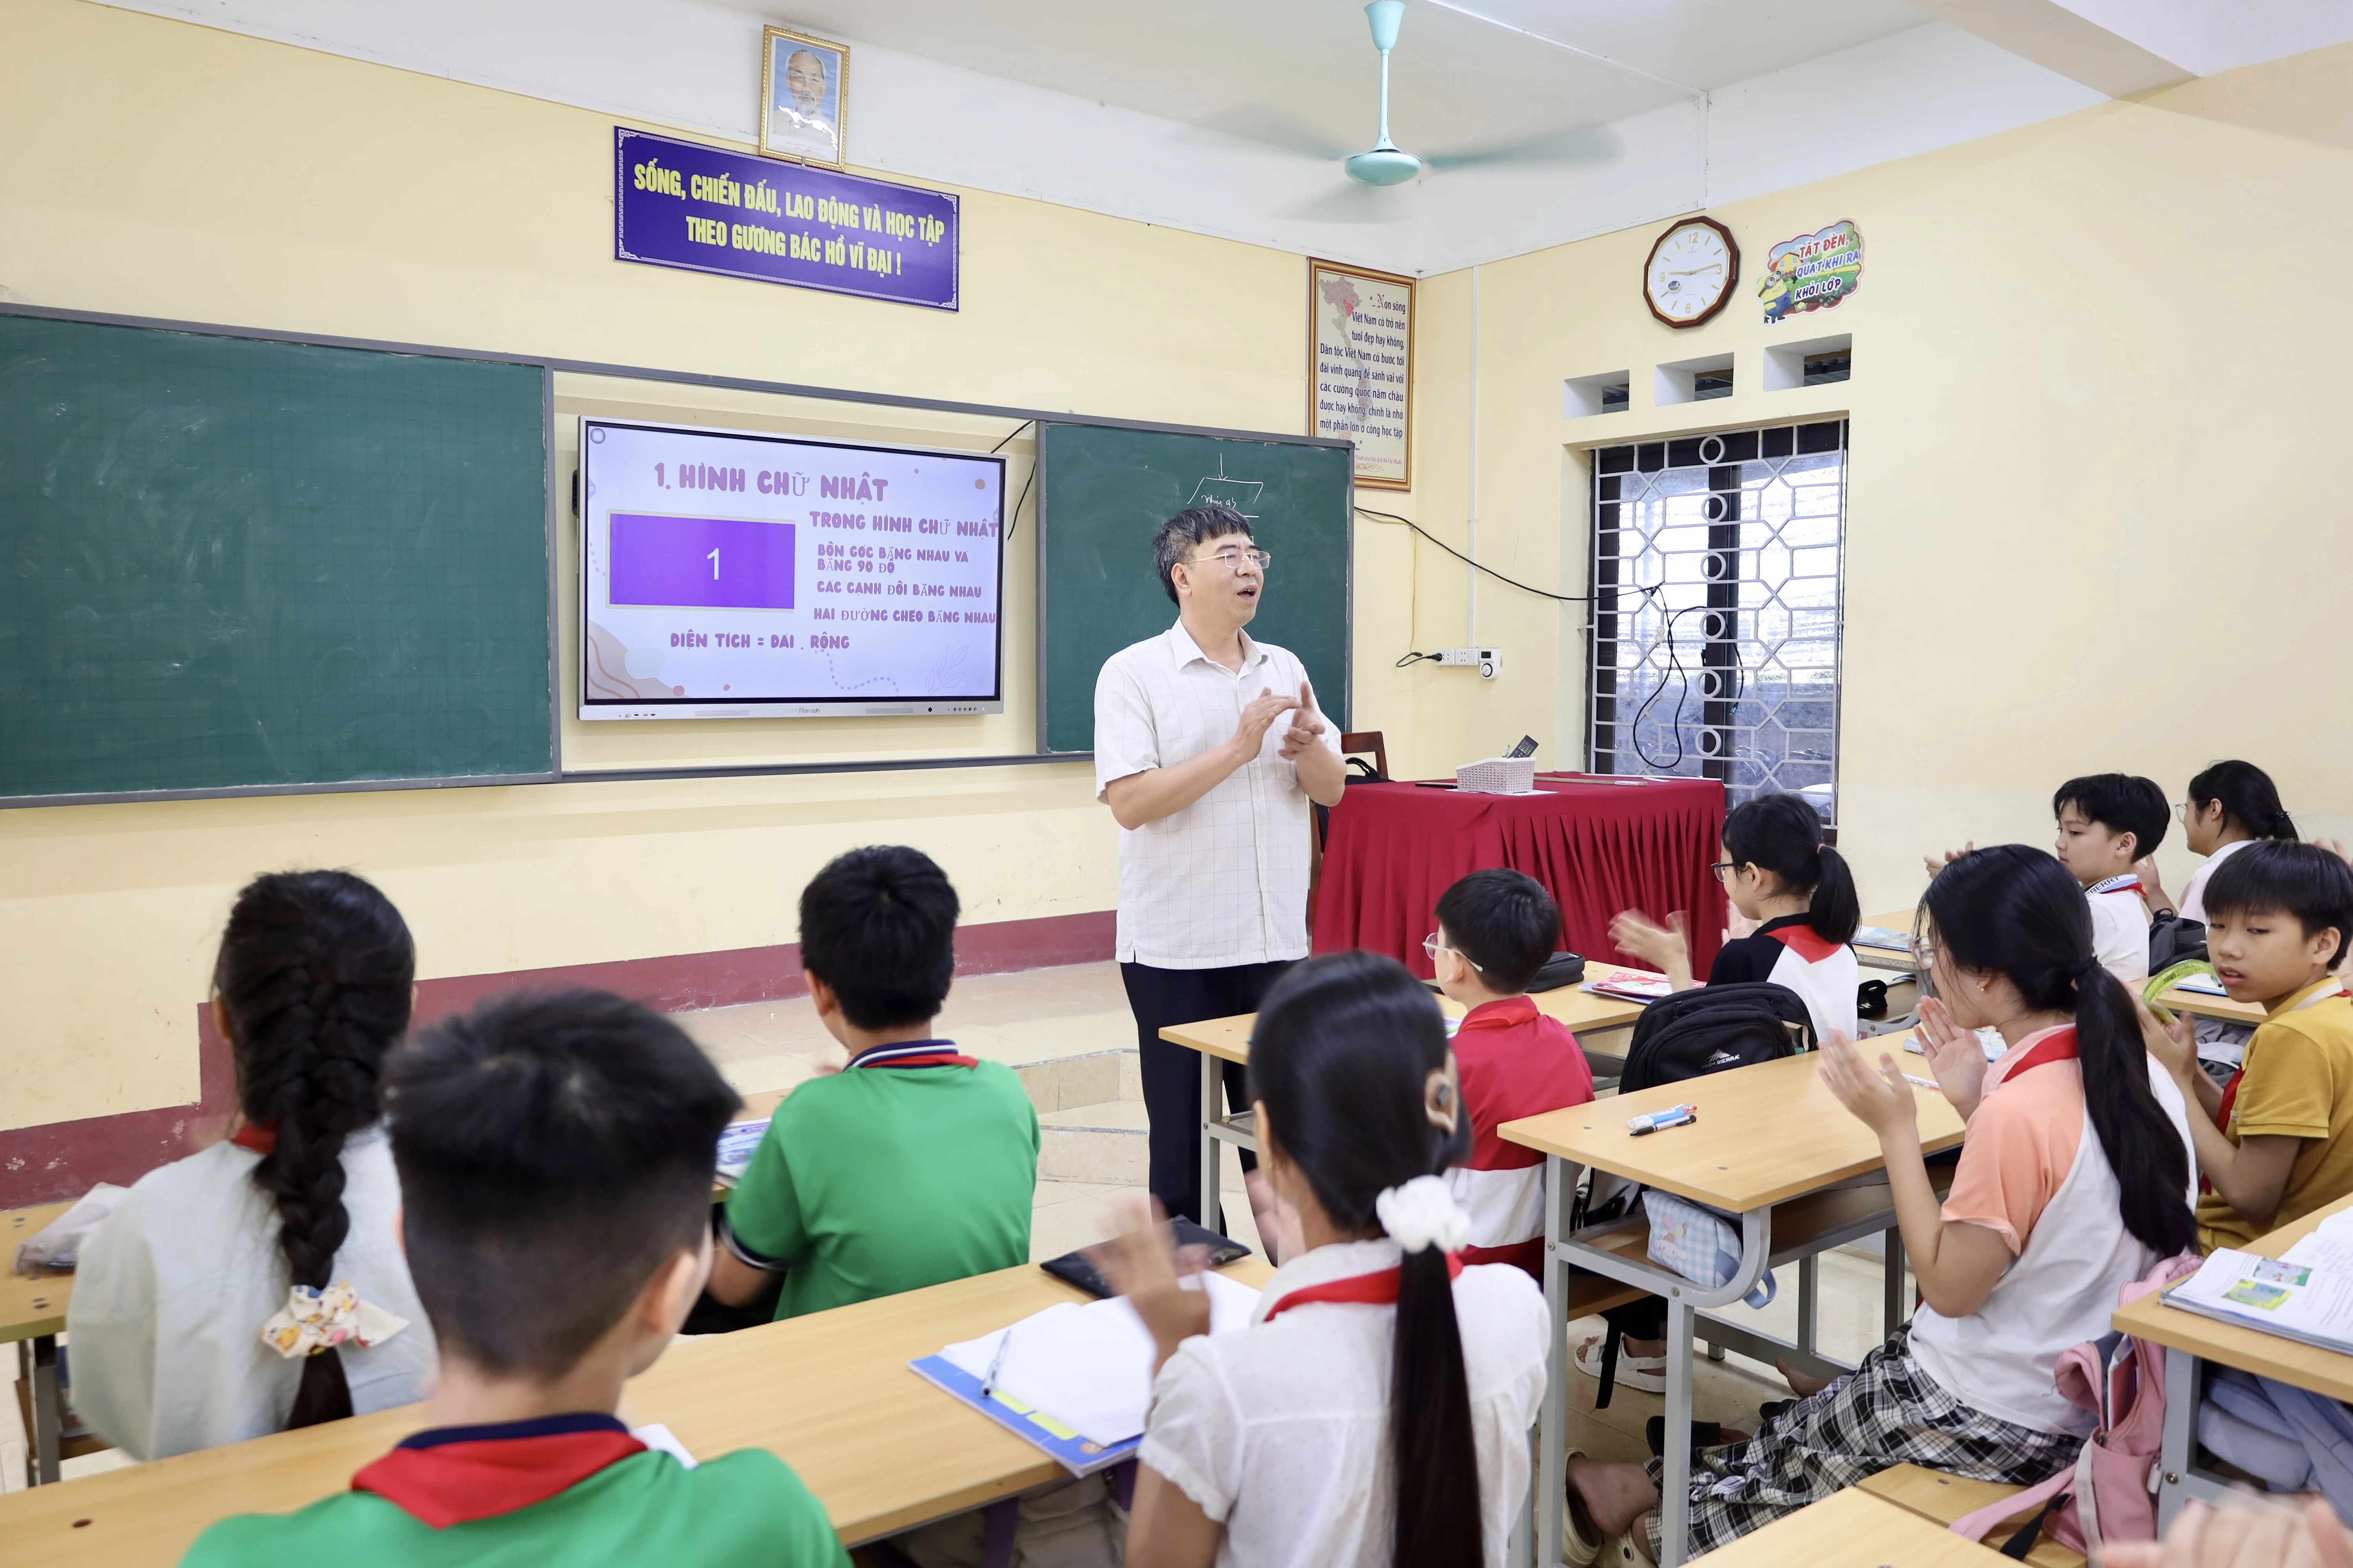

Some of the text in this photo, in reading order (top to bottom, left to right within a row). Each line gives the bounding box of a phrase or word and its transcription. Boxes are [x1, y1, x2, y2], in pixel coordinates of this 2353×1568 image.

[634, 158, 945, 247] SỐNG, CHIẾN ĐẤU, LAO ĐỘNG VÀ HỌC TẬP
[686, 216, 901, 278] THEO GƯƠNG BÁC HỒ VĨ ĐẠI !
[1688, 232, 1699, 244] 12
[1799, 233, 1848, 259] TẮT ĐÈN,
[1716, 263, 1723, 275] 3
[1797, 250, 1859, 278] QUẠT KHI RA
[1659, 272, 1666, 283] 9
[1795, 278, 1841, 300] KHỎI LỚP
[1392, 301, 1405, 315] sông
[1685, 303, 1692, 314] 6
[1352, 311, 1363, 325] Việt
[1364, 313, 1376, 326] Nam
[1378, 316, 1384, 327] có
[1395, 319, 1405, 330] nên
[1352, 330, 1405, 350] tươi đẹp hay không,
[1320, 343, 1332, 355] Dân
[1334, 346, 1343, 359] tộc
[1345, 347, 1356, 361] Việt
[1358, 349, 1371, 361] Nam
[1373, 352, 1379, 362] có
[1381, 352, 1395, 365] bước
[1320, 362, 1329, 373] đài
[1330, 364, 1343, 375] vinh
[1344, 367, 1362, 380] quang
[1363, 367, 1370, 379] để
[1372, 370, 1385, 381] sánh
[1320, 381, 1403, 402] các cường quốc năm châu
[1320, 399, 1403, 420] được hay không, chính là nhờ
[1320, 419, 1332, 431] một
[1350, 421, 1359, 432] lớn
[1361, 422, 1365, 433] ở
[1366, 424, 1380, 437] công
[1382, 425, 1392, 438] học
[1394, 427, 1403, 439] tập
[654, 462, 889, 505] 1. HÌNH CHỮ NHẬT
[809, 511, 999, 540] TRONG HÌNH CHỮ NHẬT
[707, 547, 720, 580] 1
[850, 545, 874, 558] GÓC
[917, 549, 950, 562] NHAU
[955, 550, 968, 563] VÀ
[858, 561, 873, 573] 90
[879, 558, 895, 575] ĐỘ
[817, 579, 842, 593] CÁC
[847, 582, 881, 596] CẠNH
[950, 585, 981, 598] NHAU
[814, 608, 835, 620] HAI
[841, 608, 888, 621] ĐƯỜNG
[893, 608, 923, 622] CHÉO
[964, 611, 996, 624] NHAU
[670, 629, 707, 650] DIỆN
[714, 632, 750, 648] TÍCH
[757, 637, 764, 646] =
[771, 633, 794, 648] DÀI
